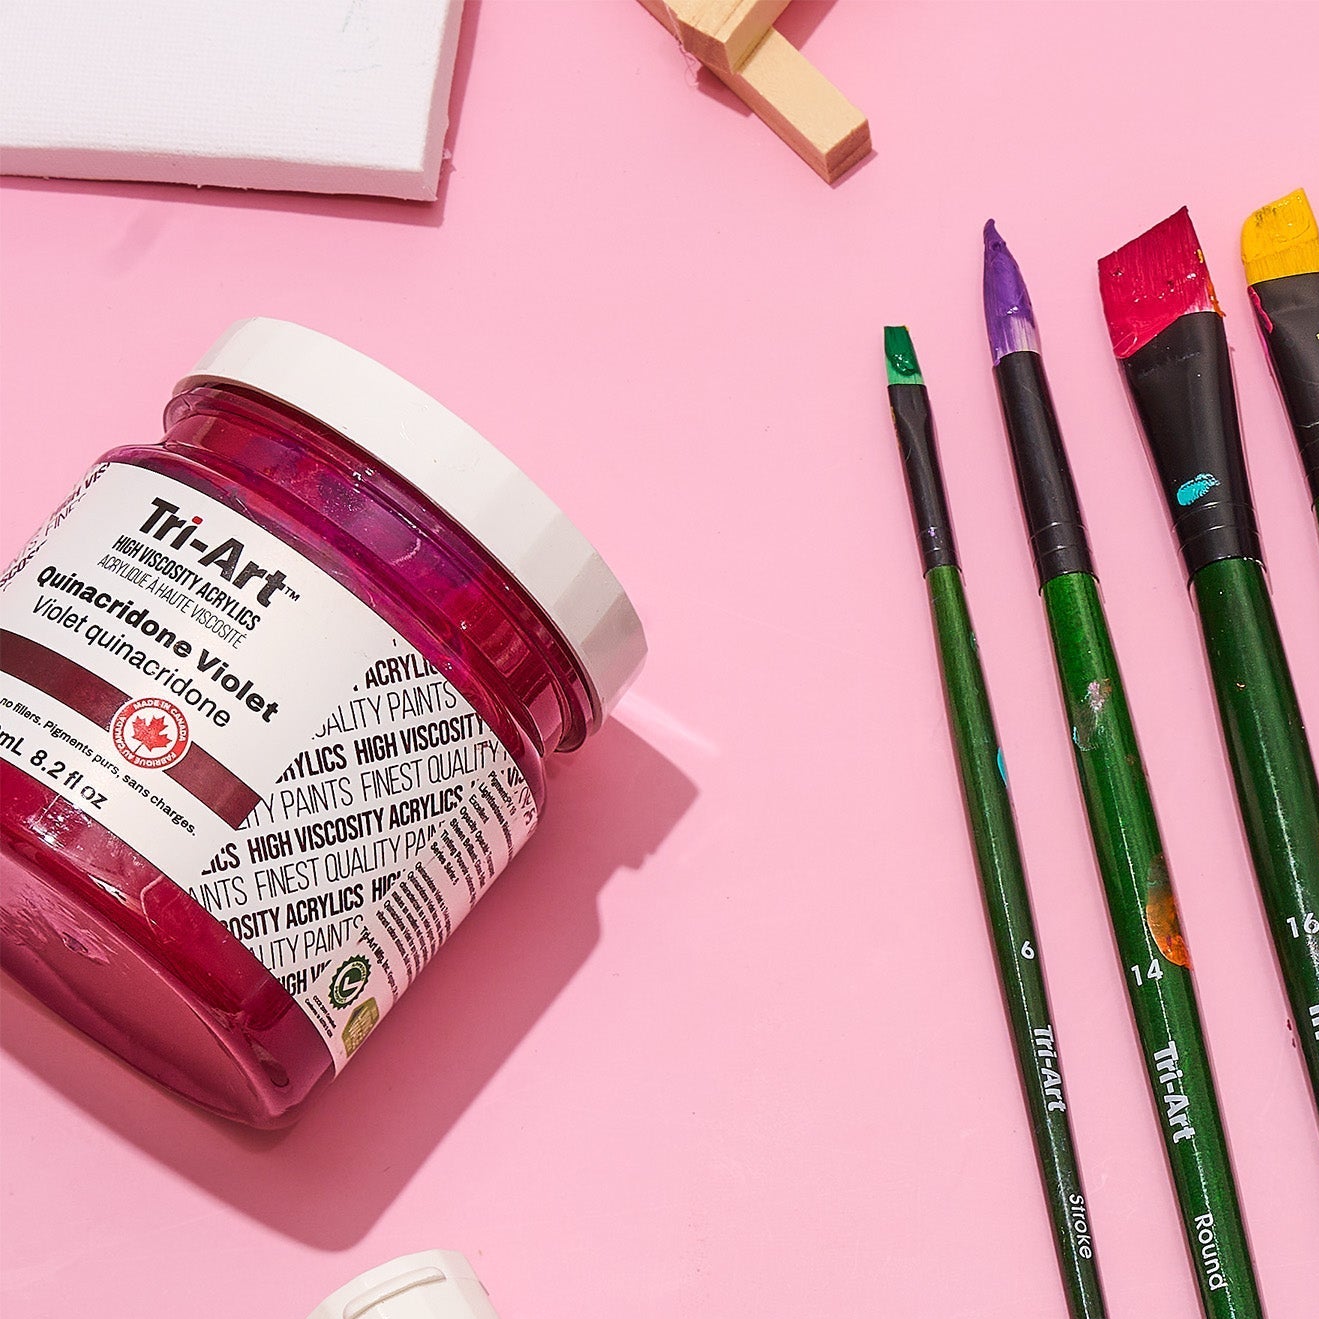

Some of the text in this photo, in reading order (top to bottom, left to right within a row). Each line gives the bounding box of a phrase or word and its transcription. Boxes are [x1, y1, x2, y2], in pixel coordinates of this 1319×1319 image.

[97, 554, 247, 650] ACRYLIQUE HAUTE VISCOSITÉ
[112, 534, 261, 631] HIGH VISCOSITY ACRYLICS
[32, 595, 231, 727] Violet quinacridone
[36, 565, 280, 724] Quinacridone Violet
[30, 749, 109, 810] 8.2 oz
[43, 720, 197, 836] Pigments purs, sans charges.
[247, 807, 384, 864] HIGH VISCOSITY
[1021, 940, 1035, 960] 6
[1286, 913, 1319, 939] 16
[1131, 958, 1163, 987] 14
[1033, 1025, 1066, 1112] Tri-Art
[1154, 1041, 1196, 1143] Tri-Art
[1069, 1193, 1092, 1259] Stroke
[1194, 1212, 1228, 1292] Round
